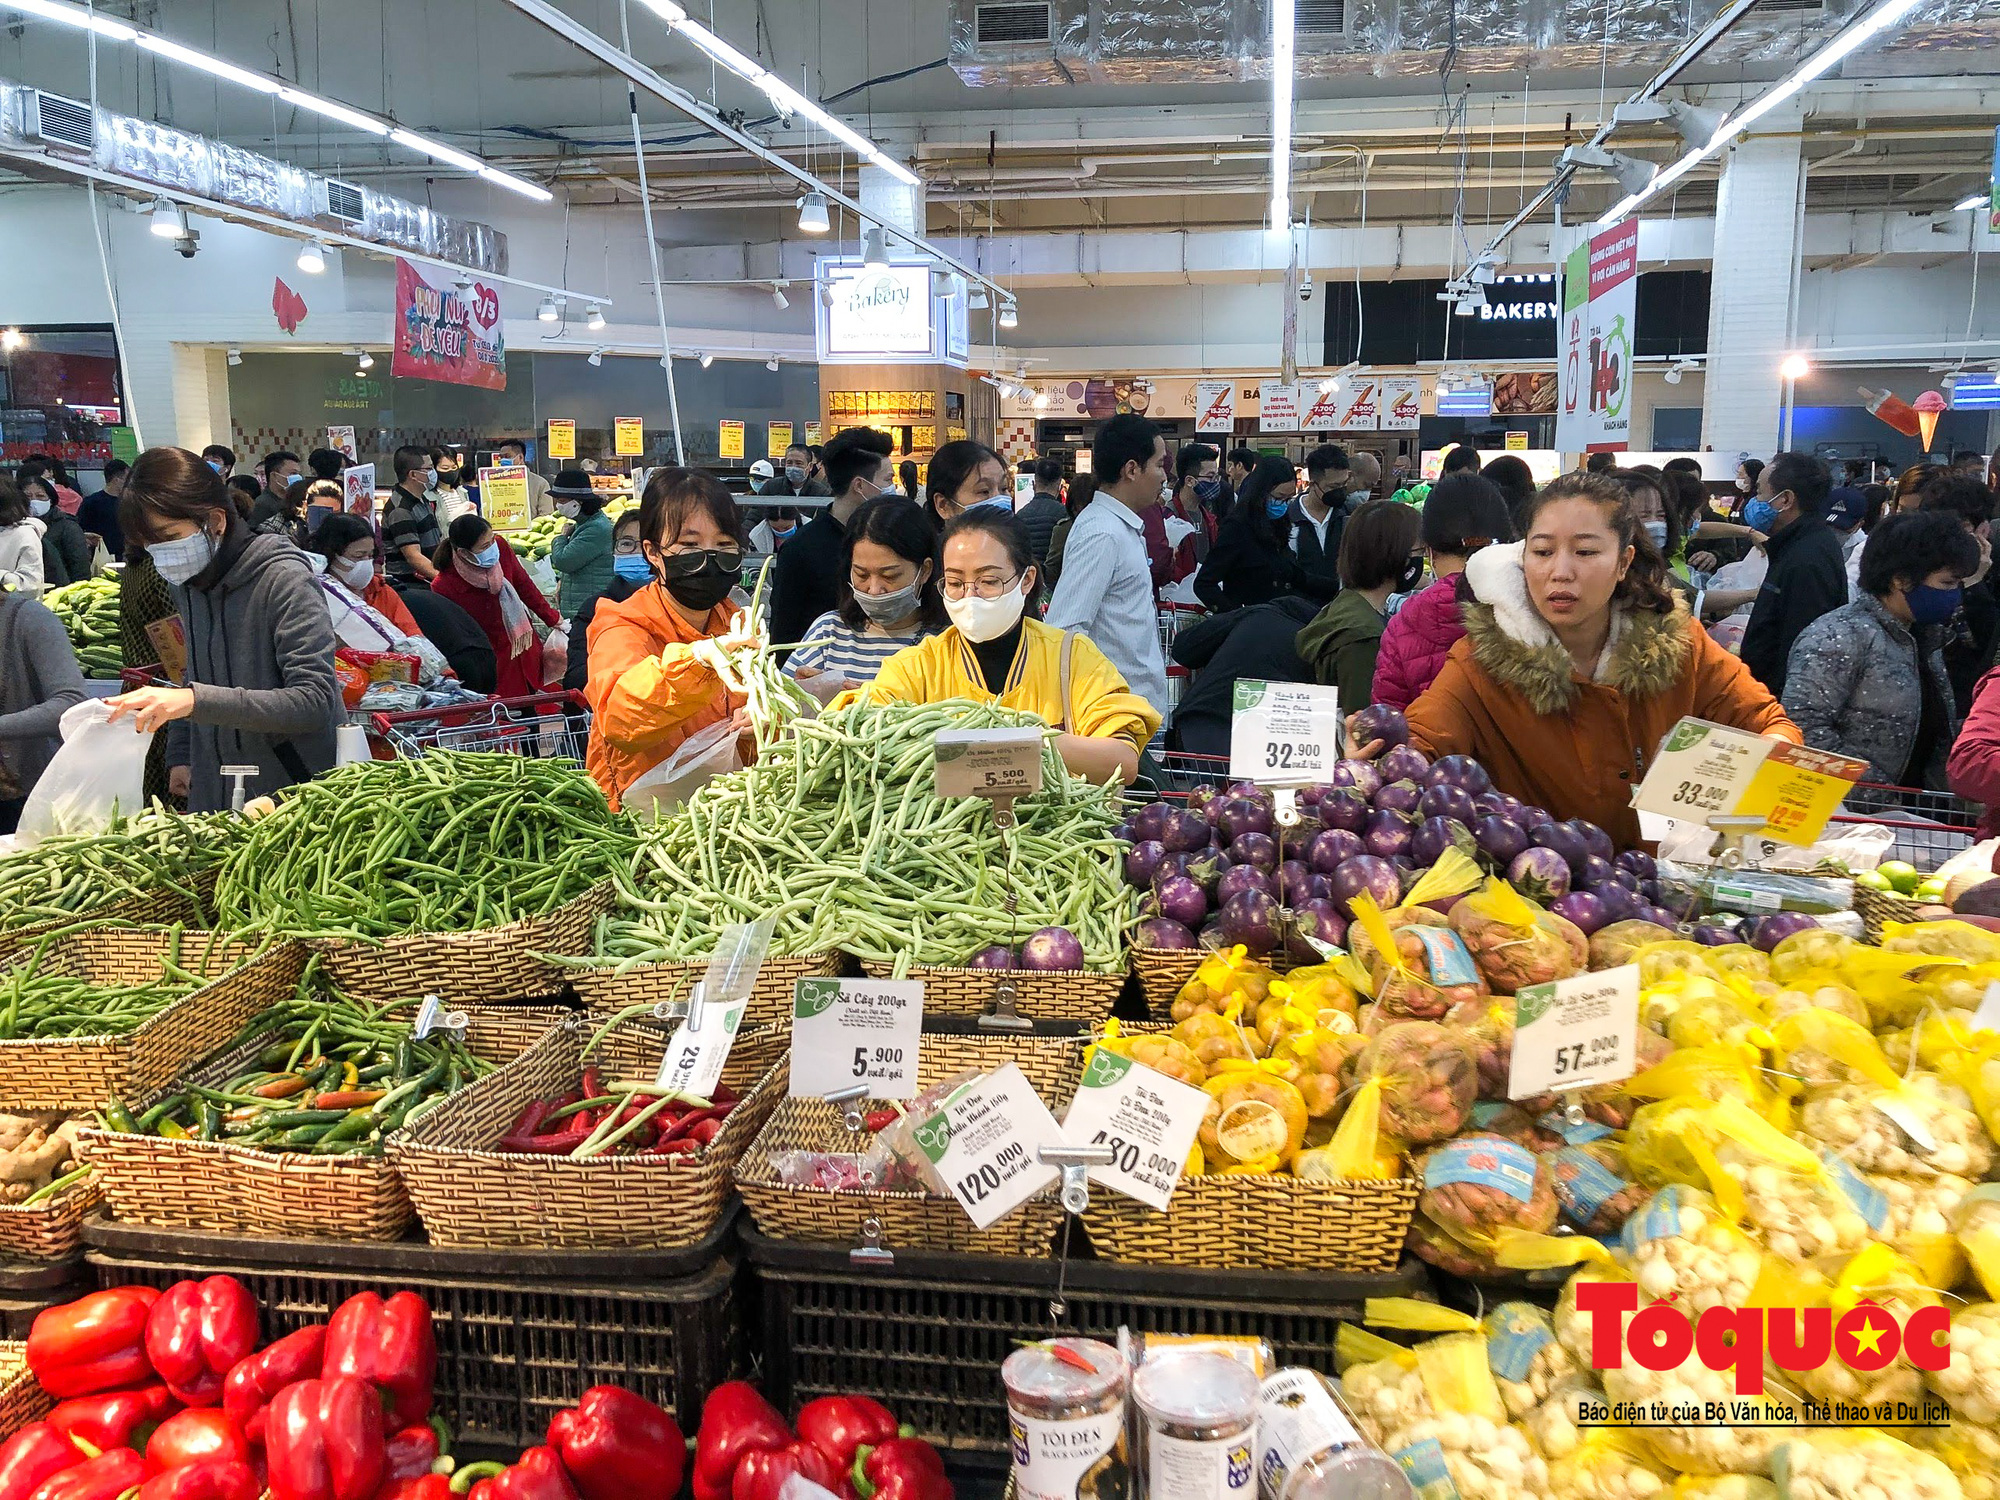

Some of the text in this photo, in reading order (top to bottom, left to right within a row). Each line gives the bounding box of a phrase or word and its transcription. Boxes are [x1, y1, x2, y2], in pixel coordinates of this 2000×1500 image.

[846, 286, 910, 312] Bakery
[1480, 302, 1558, 320] BAKERY
[1266, 742, 1320, 768] 32.900
[985, 769, 1024, 787] 5.500
[1673, 781, 1729, 804] 33.000
[854, 992, 873, 1007] Cây
[852, 1046, 903, 1077] 5.900
[957, 1141, 1024, 1206] 120.000
[1002, 1155, 1032, 1182] vnđ/gói
